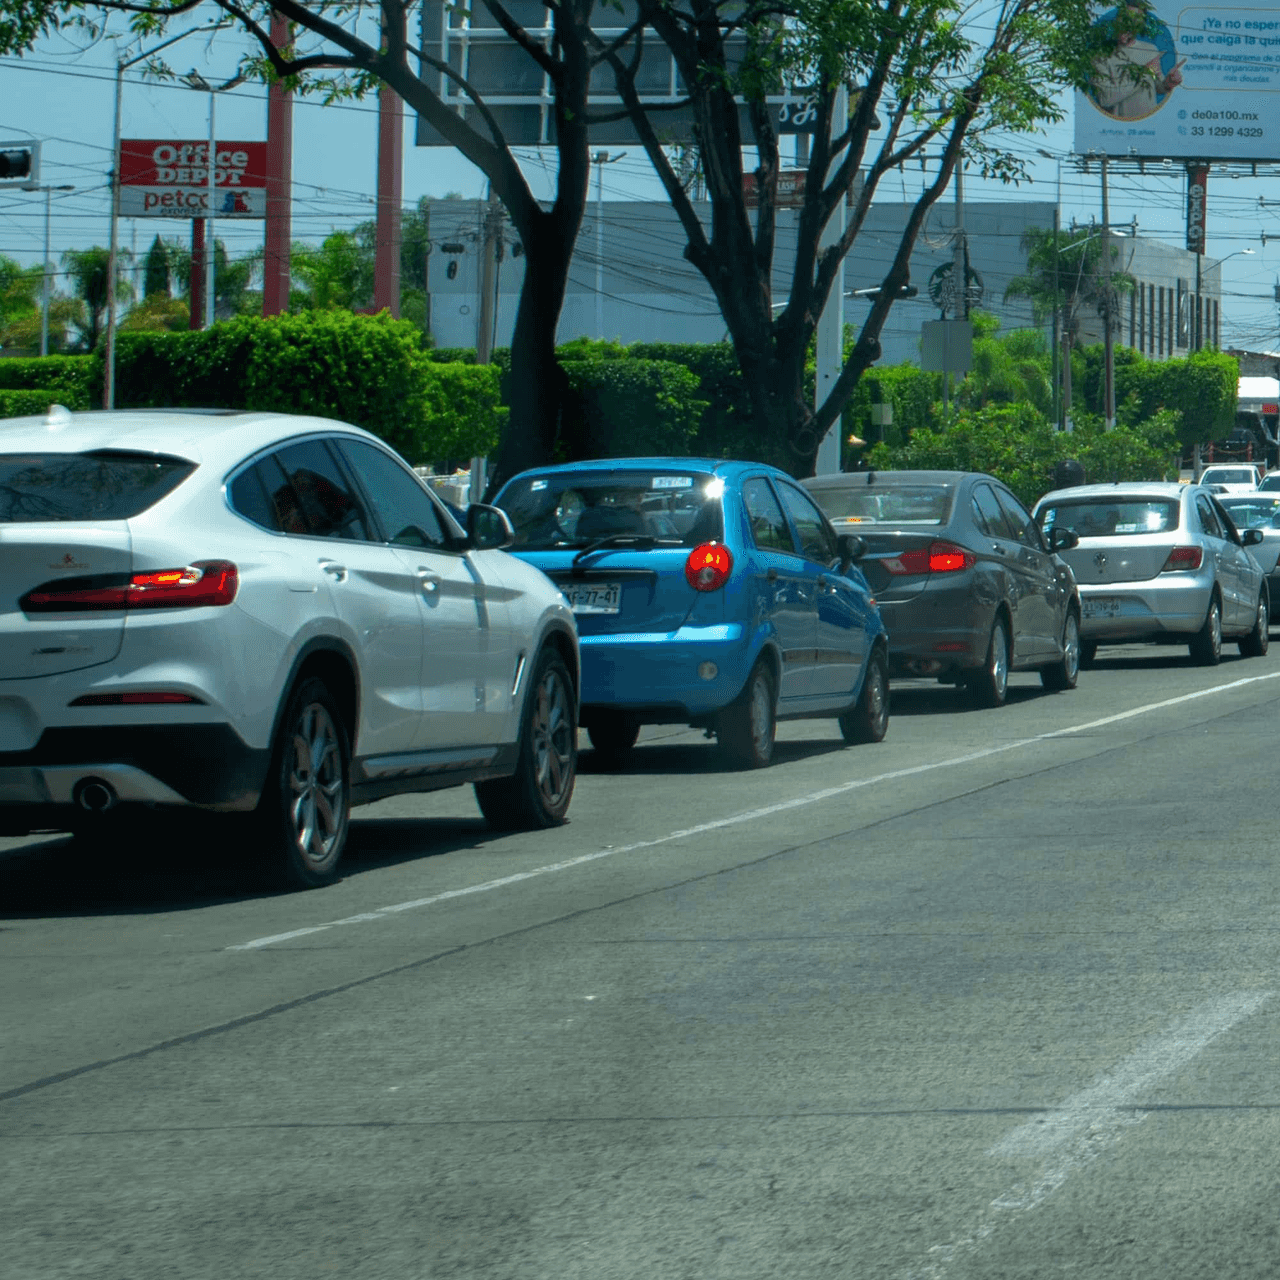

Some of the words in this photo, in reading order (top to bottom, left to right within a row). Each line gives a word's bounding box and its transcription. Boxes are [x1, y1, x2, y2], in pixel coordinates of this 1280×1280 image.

[1203, 18, 1222, 30] ¡Ya
[1225, 21, 1241, 29] no
[1181, 35, 1204, 46] que
[1207, 34, 1241, 47] caiga
[1244, 35, 1256, 45] la
[1191, 109, 1259, 121] de0a100.mx
[1191, 127, 1205, 137] 33
[1208, 127, 1234, 137] 1299
[1236, 127, 1264, 138] 4329
[152, 143, 249, 168] Offce
[154, 168, 245, 185] DEPOT
